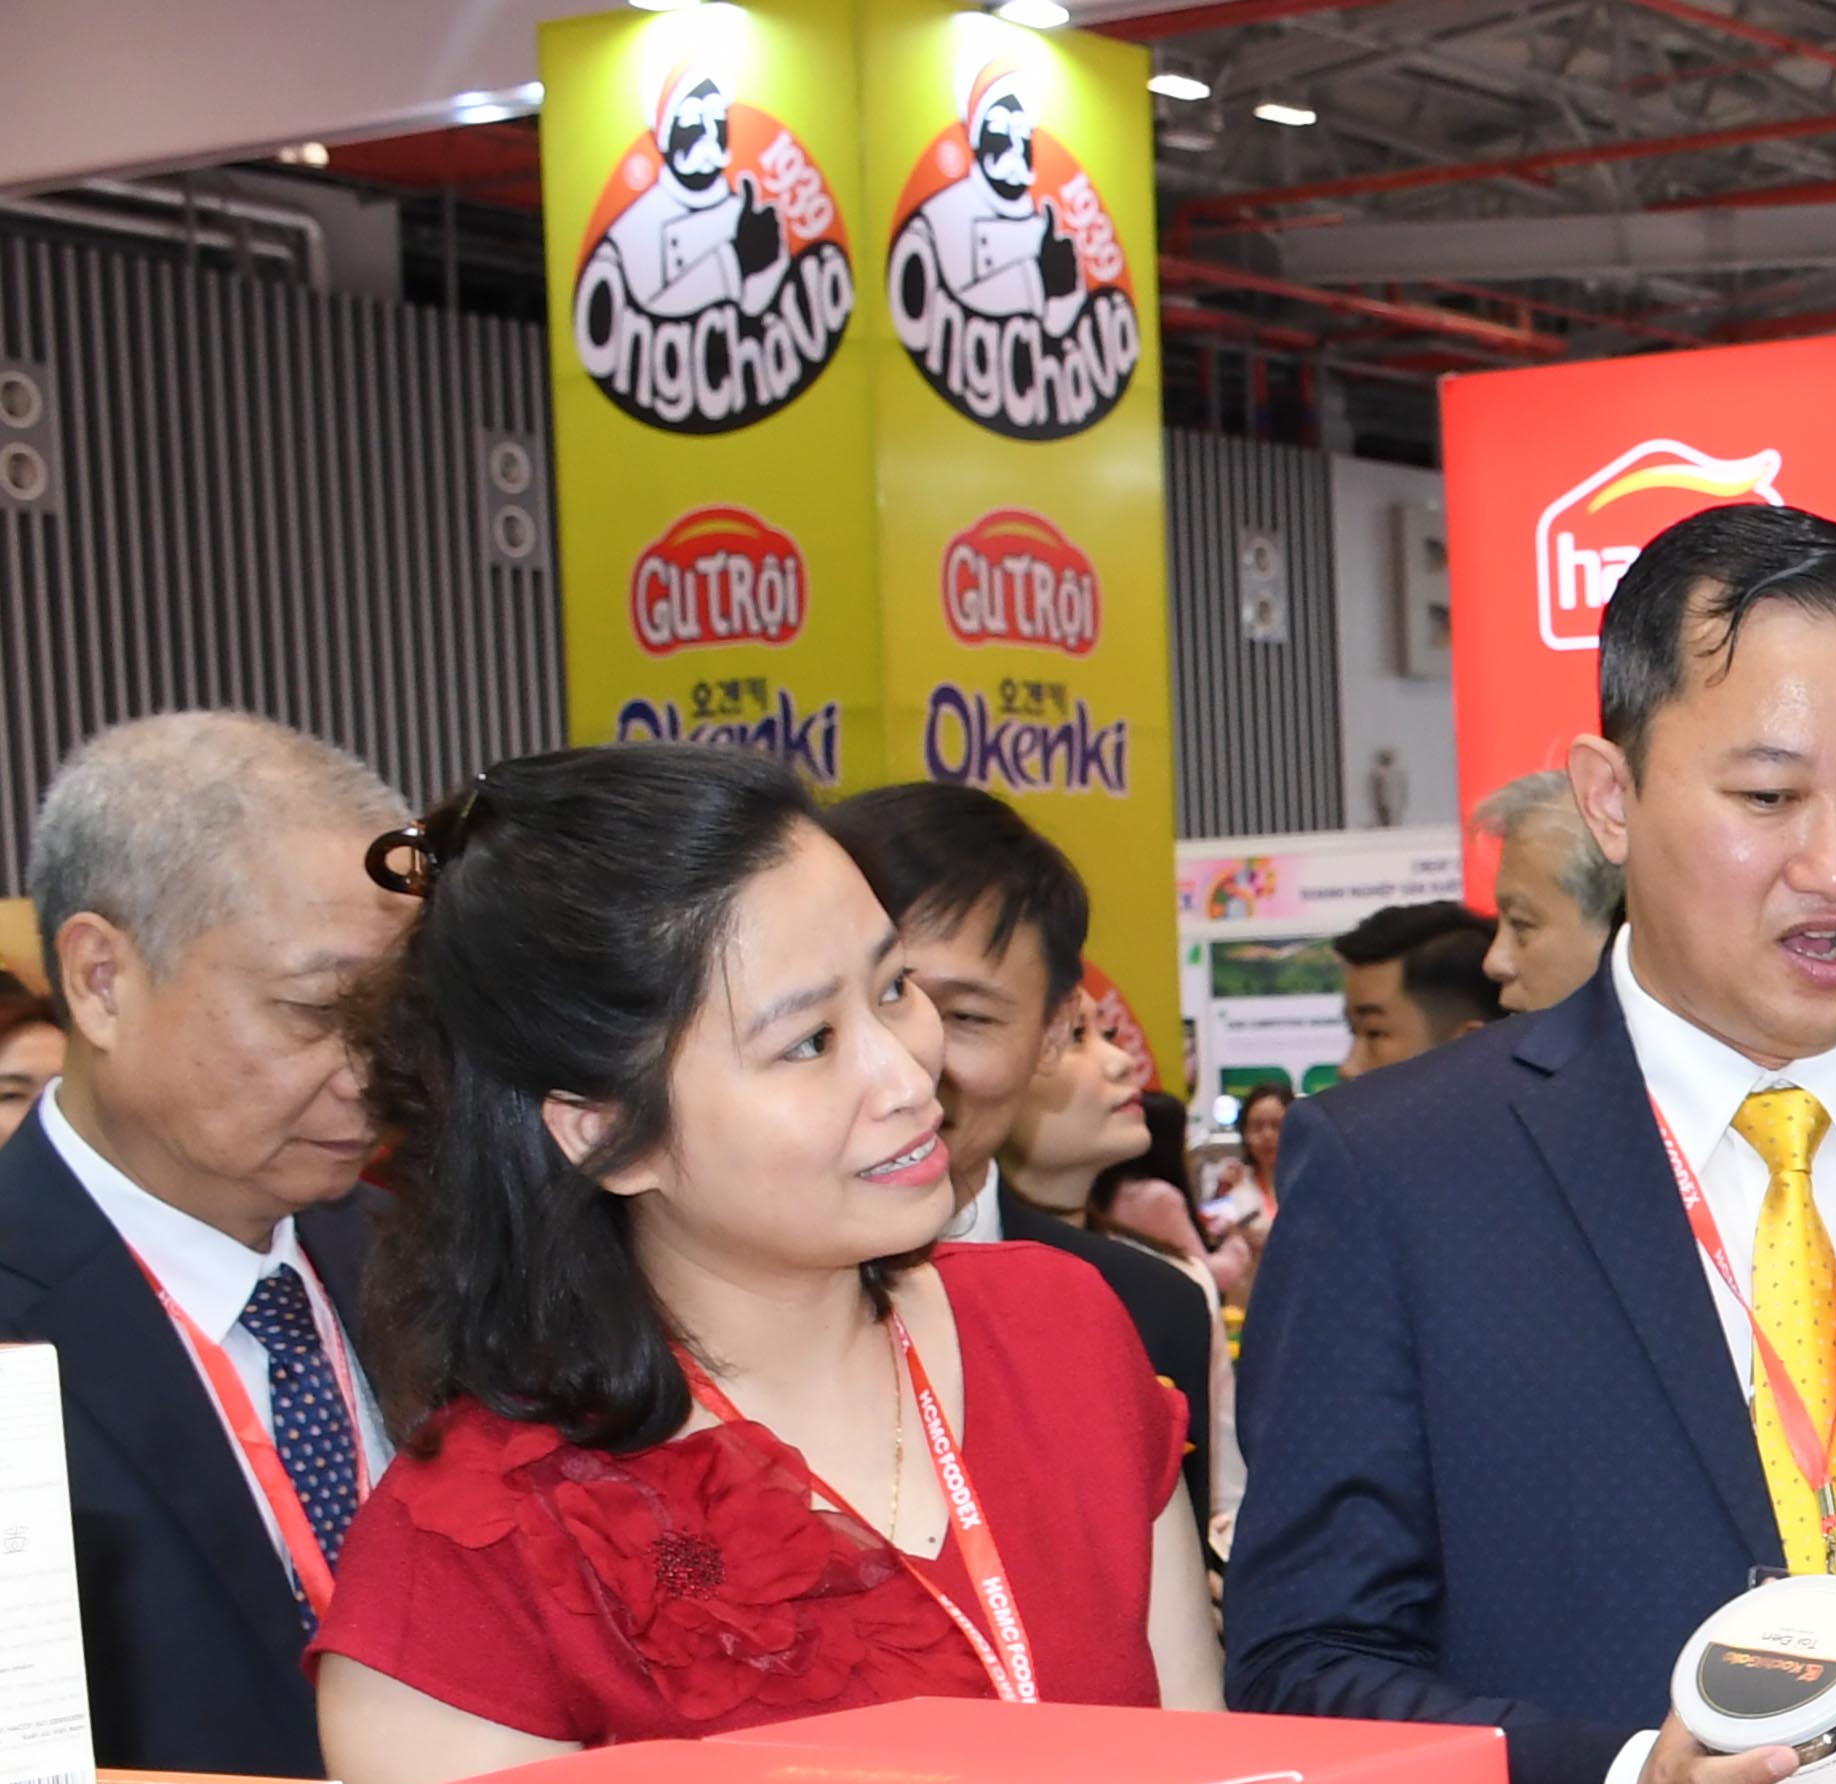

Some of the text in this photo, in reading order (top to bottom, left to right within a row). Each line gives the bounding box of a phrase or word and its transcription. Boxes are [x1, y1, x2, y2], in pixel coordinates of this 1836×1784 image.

[924, 682, 1130, 797] Okenki
[919, 1389, 950, 1454] HCMC
[982, 1576, 1020, 1642] HCMC
